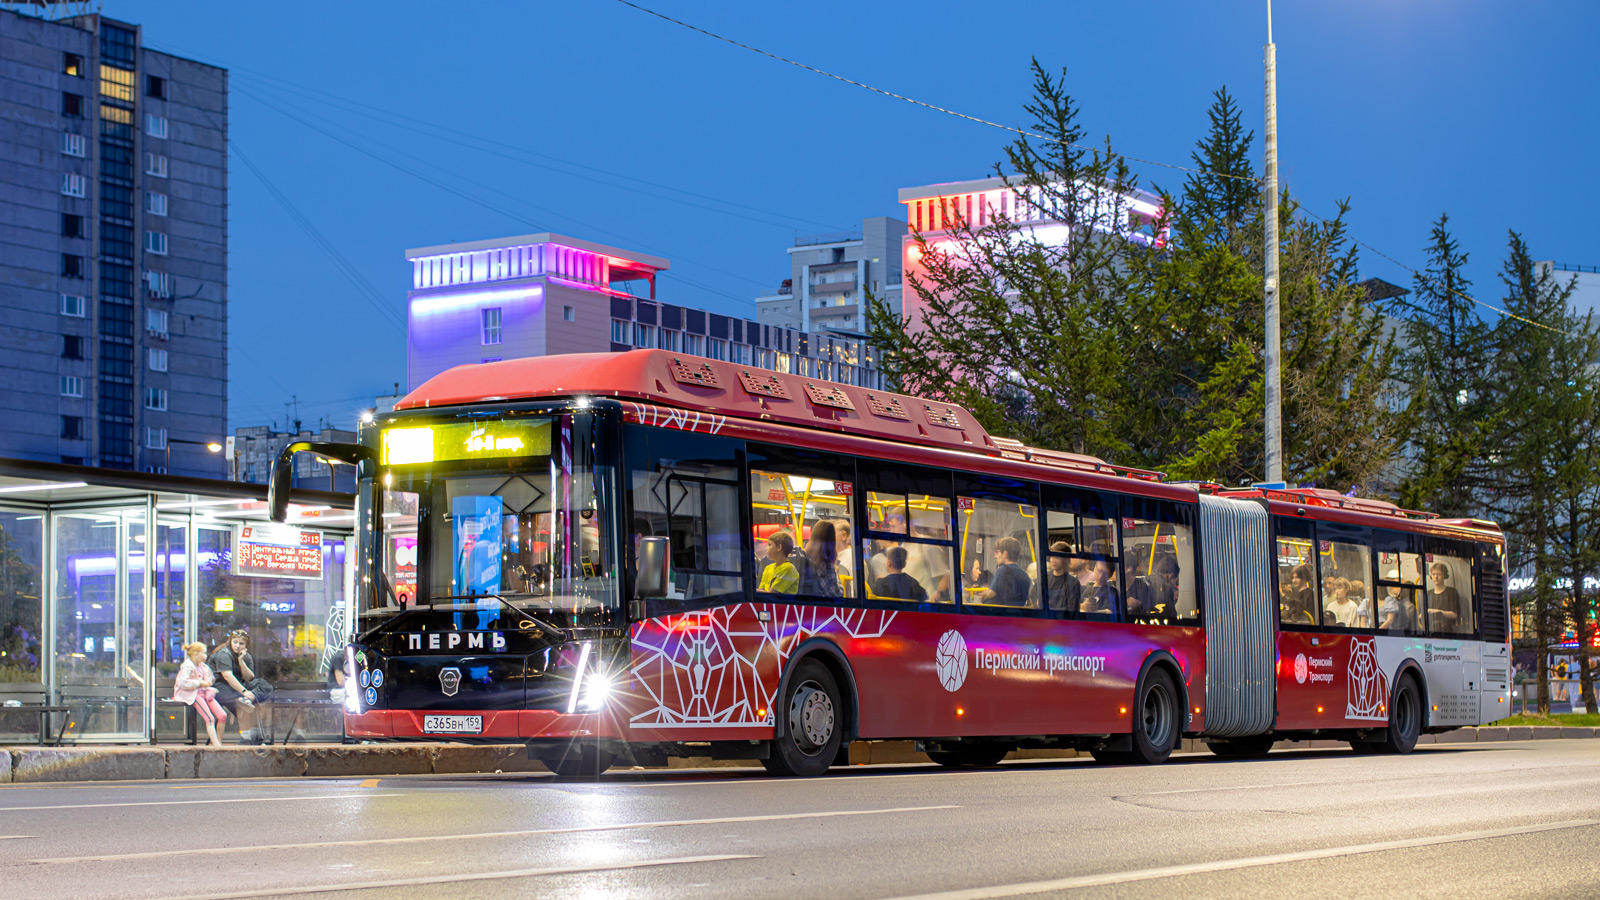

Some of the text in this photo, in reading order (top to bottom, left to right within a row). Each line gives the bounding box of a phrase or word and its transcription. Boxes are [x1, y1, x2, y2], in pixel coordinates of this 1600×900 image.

[300, 533, 320, 544] 23:15
[251, 543, 296, 555] Центральный
[251, 551, 272, 562] Город
[408, 632, 506, 650] ПЕРМЬ
[975, 648, 1106, 677] Пермский транспорт
[1308, 656, 1333, 669] Пермский
[1309, 671, 1334, 684] Транспорт
[427, 717, 480, 730] С365ВН 159
